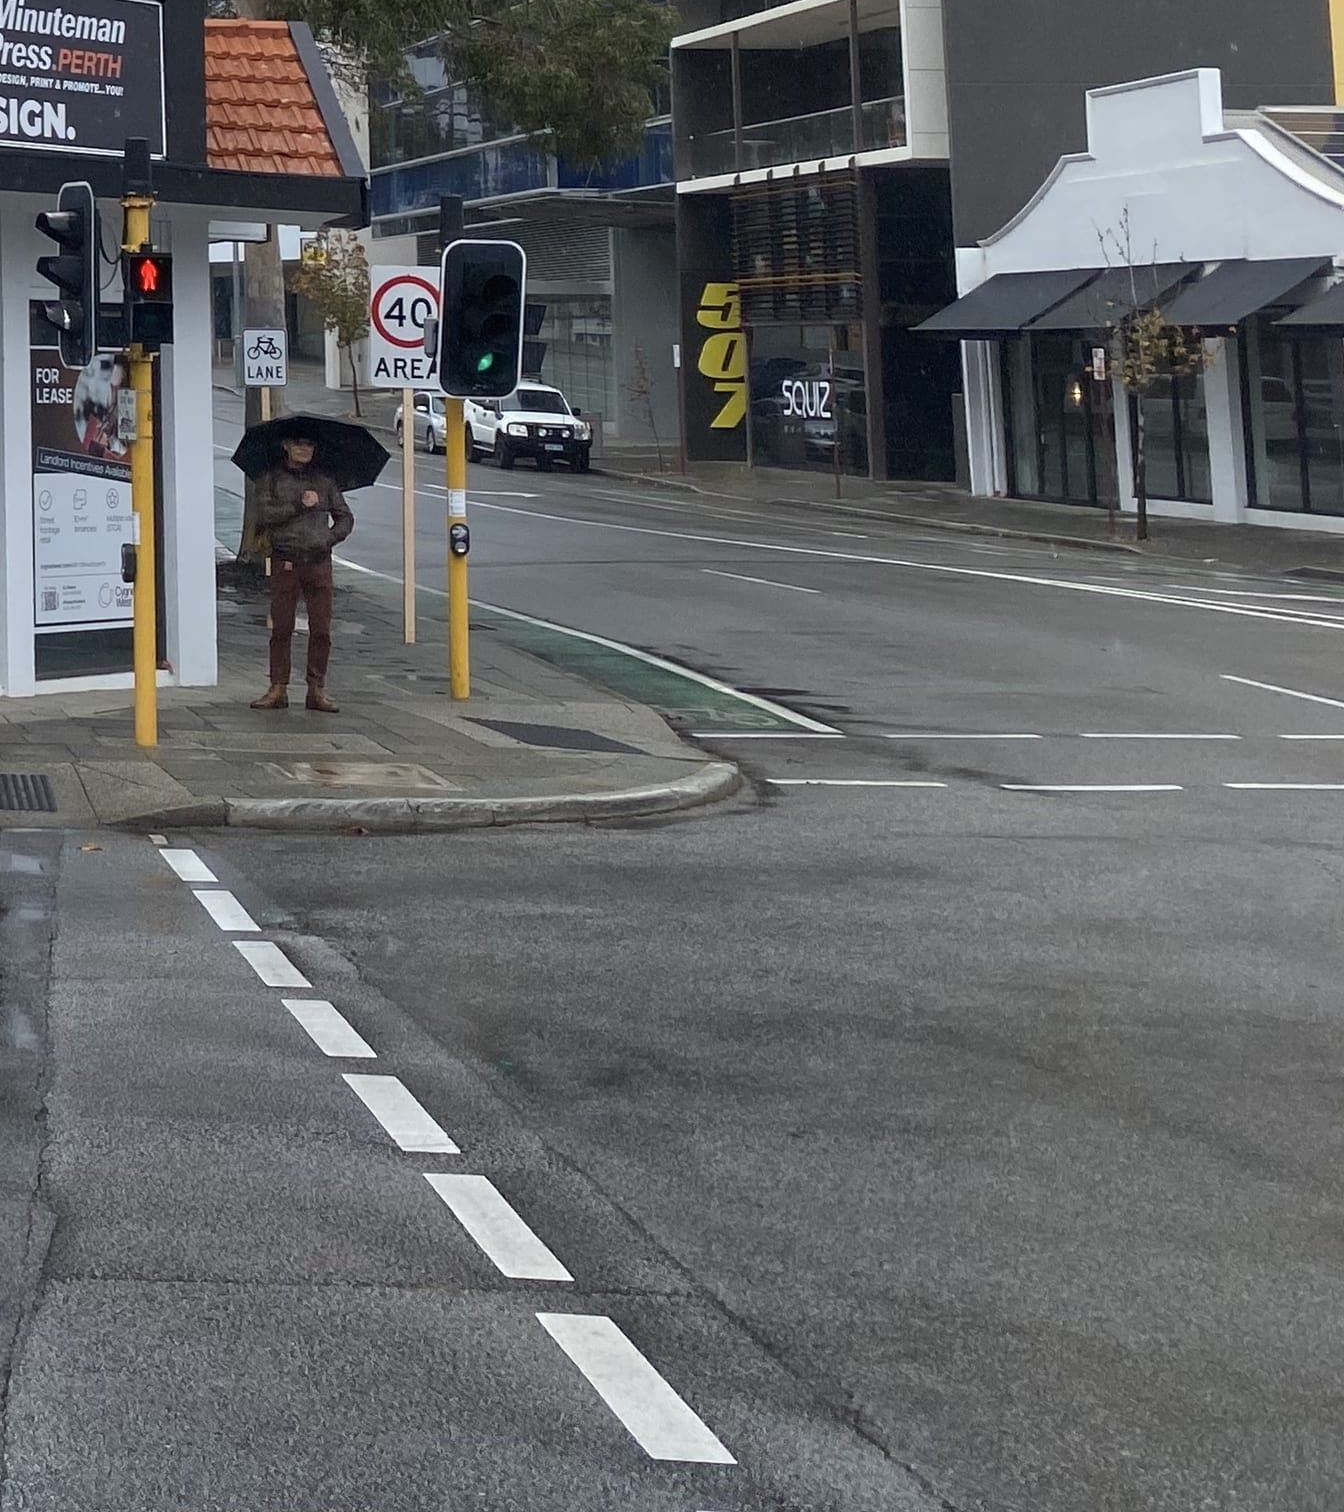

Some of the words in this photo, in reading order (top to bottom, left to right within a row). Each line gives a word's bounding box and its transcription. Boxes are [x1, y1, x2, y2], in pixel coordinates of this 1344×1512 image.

[30, 77, 54, 89] PRINT
[55, 79, 61, 90] &
[384, 297, 432, 328] 40
[696, 282, 747, 428] 507
[36, 368, 60, 384] FOR
[247, 365, 283, 379] LANE
[36, 388, 73, 404] LEASE
